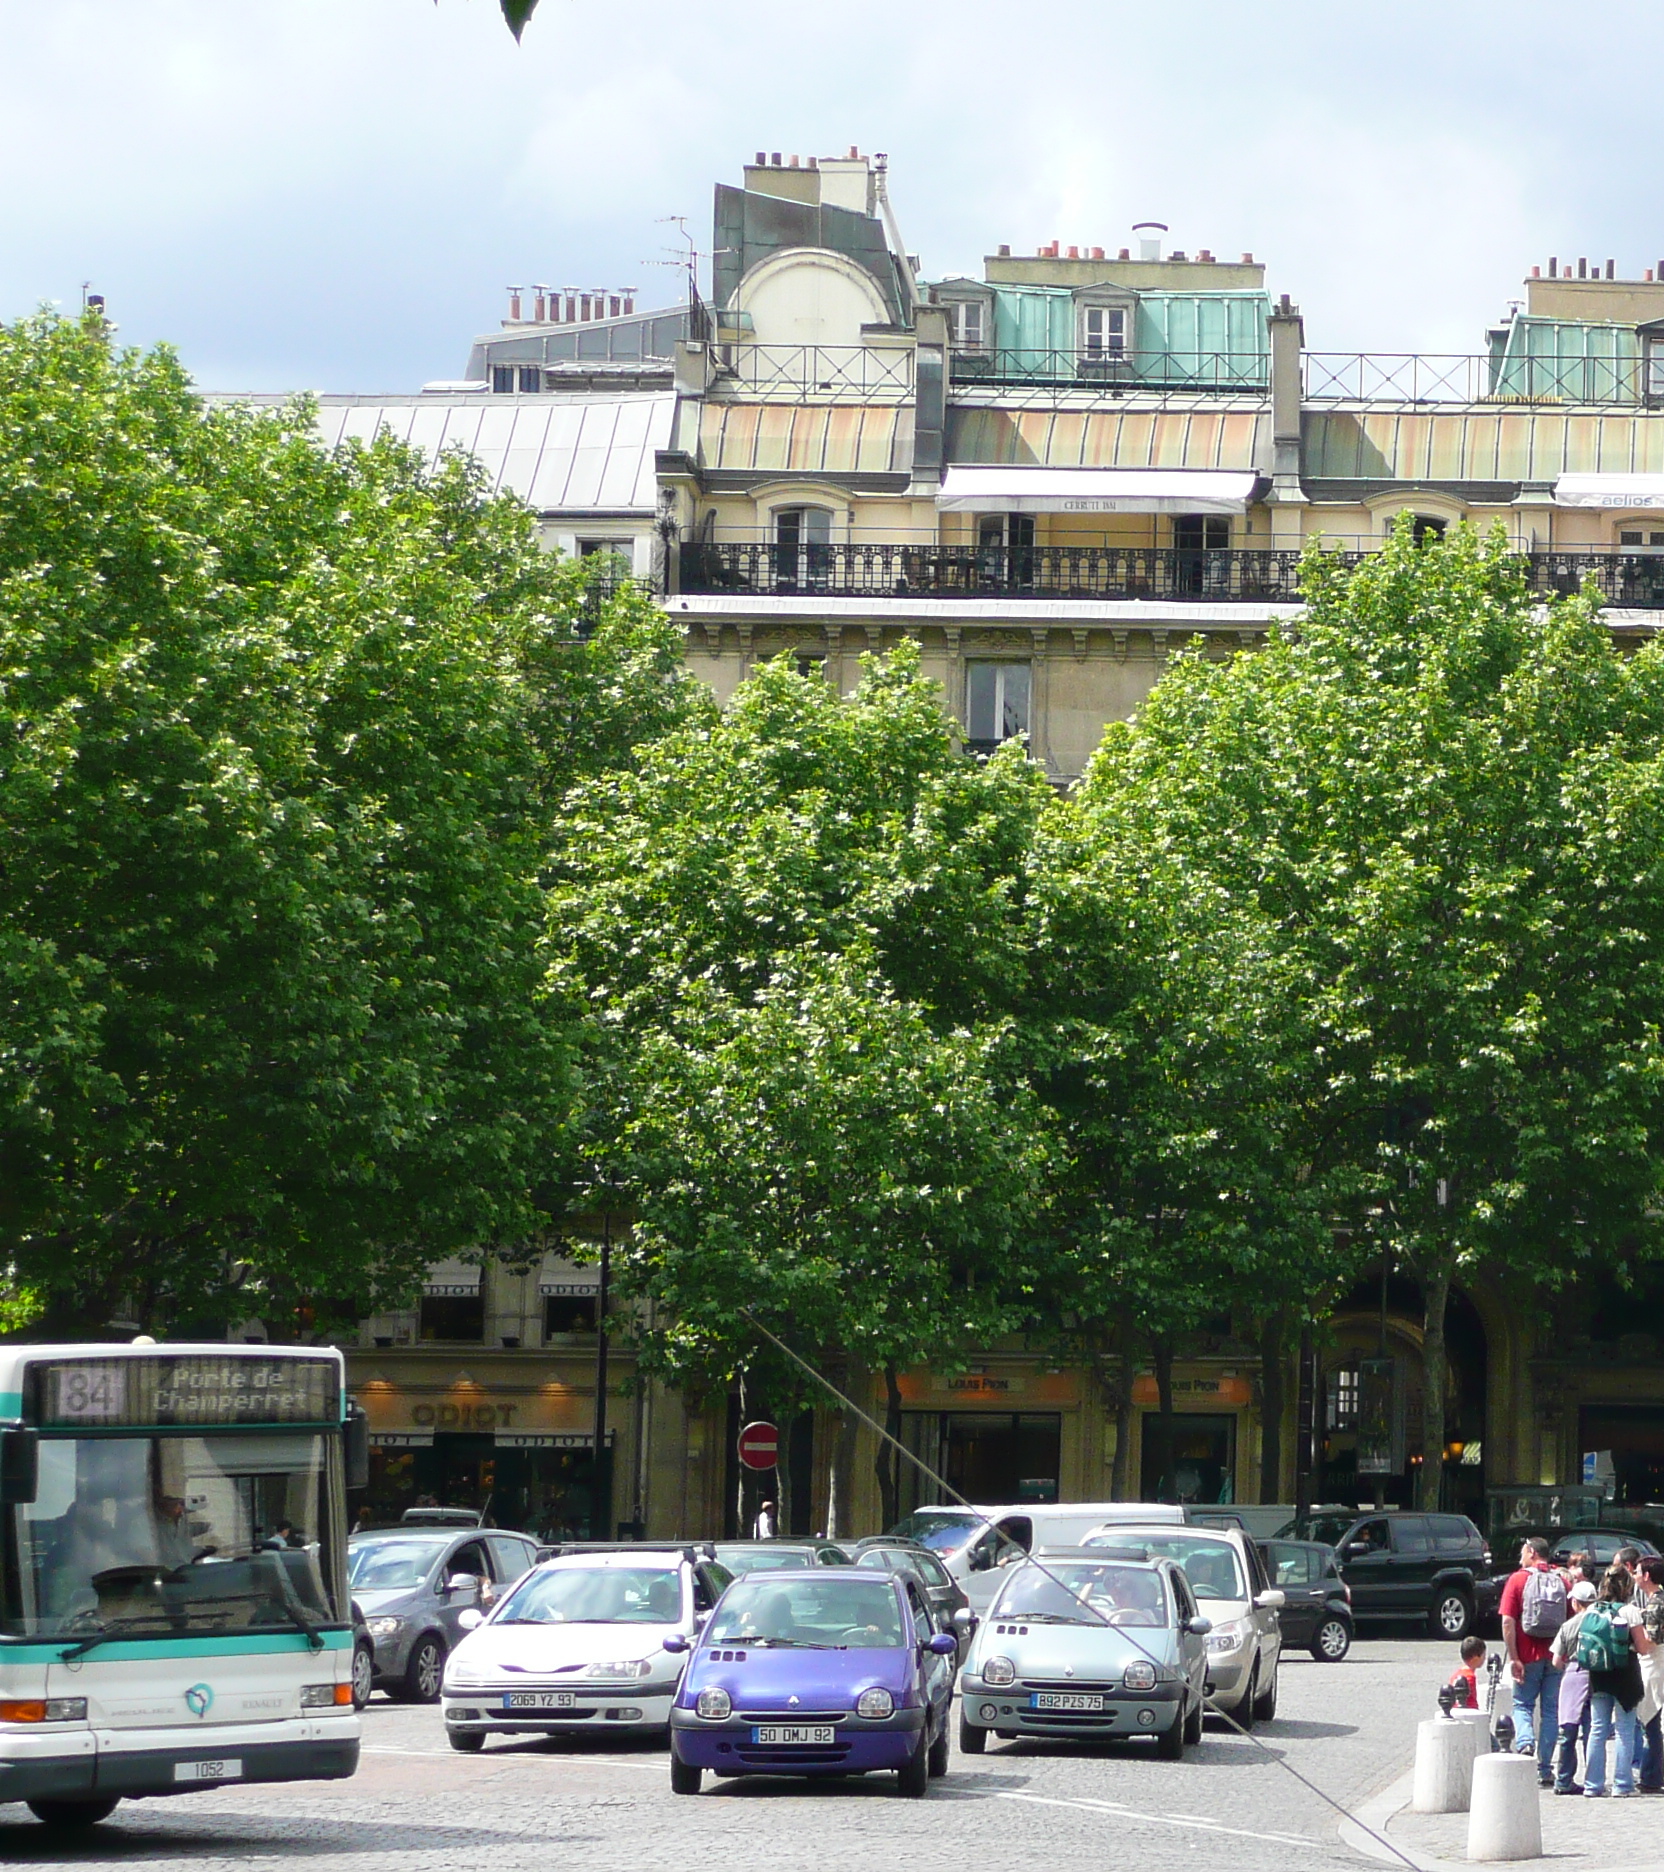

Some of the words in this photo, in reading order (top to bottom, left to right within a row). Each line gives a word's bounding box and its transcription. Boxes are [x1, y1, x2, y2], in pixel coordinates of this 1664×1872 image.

[1064, 501, 1099, 510] CERRUTI
[1602, 494, 1653, 506] aelios
[430, 1285, 475, 1296] DIOT
[540, 1285, 600, 1296] ODIOT
[173, 1368, 246, 1388] Porte
[253, 1367, 284, 1388] de
[66, 1373, 113, 1412] 84
[153, 1389, 307, 1412] Champerret
[412, 1403, 518, 1427] ODIOT
[374, 1436, 412, 1446] IOT
[514, 1436, 589, 1447] ODIOT
[242, 1698, 283, 1710] RENAULT
[510, 1694, 536, 1707] 2069
[540, 1694, 554, 1707] YZ
[558, 1694, 572, 1707] 93
[1039, 1695, 1061, 1708] 892
[1062, 1696, 1085, 1708] PZS
[1086, 1696, 1102, 1709] 75
[760, 1728, 777, 1742] 50
[814, 1728, 831, 1742] 92
[194, 1761, 224, 1778] 1052
